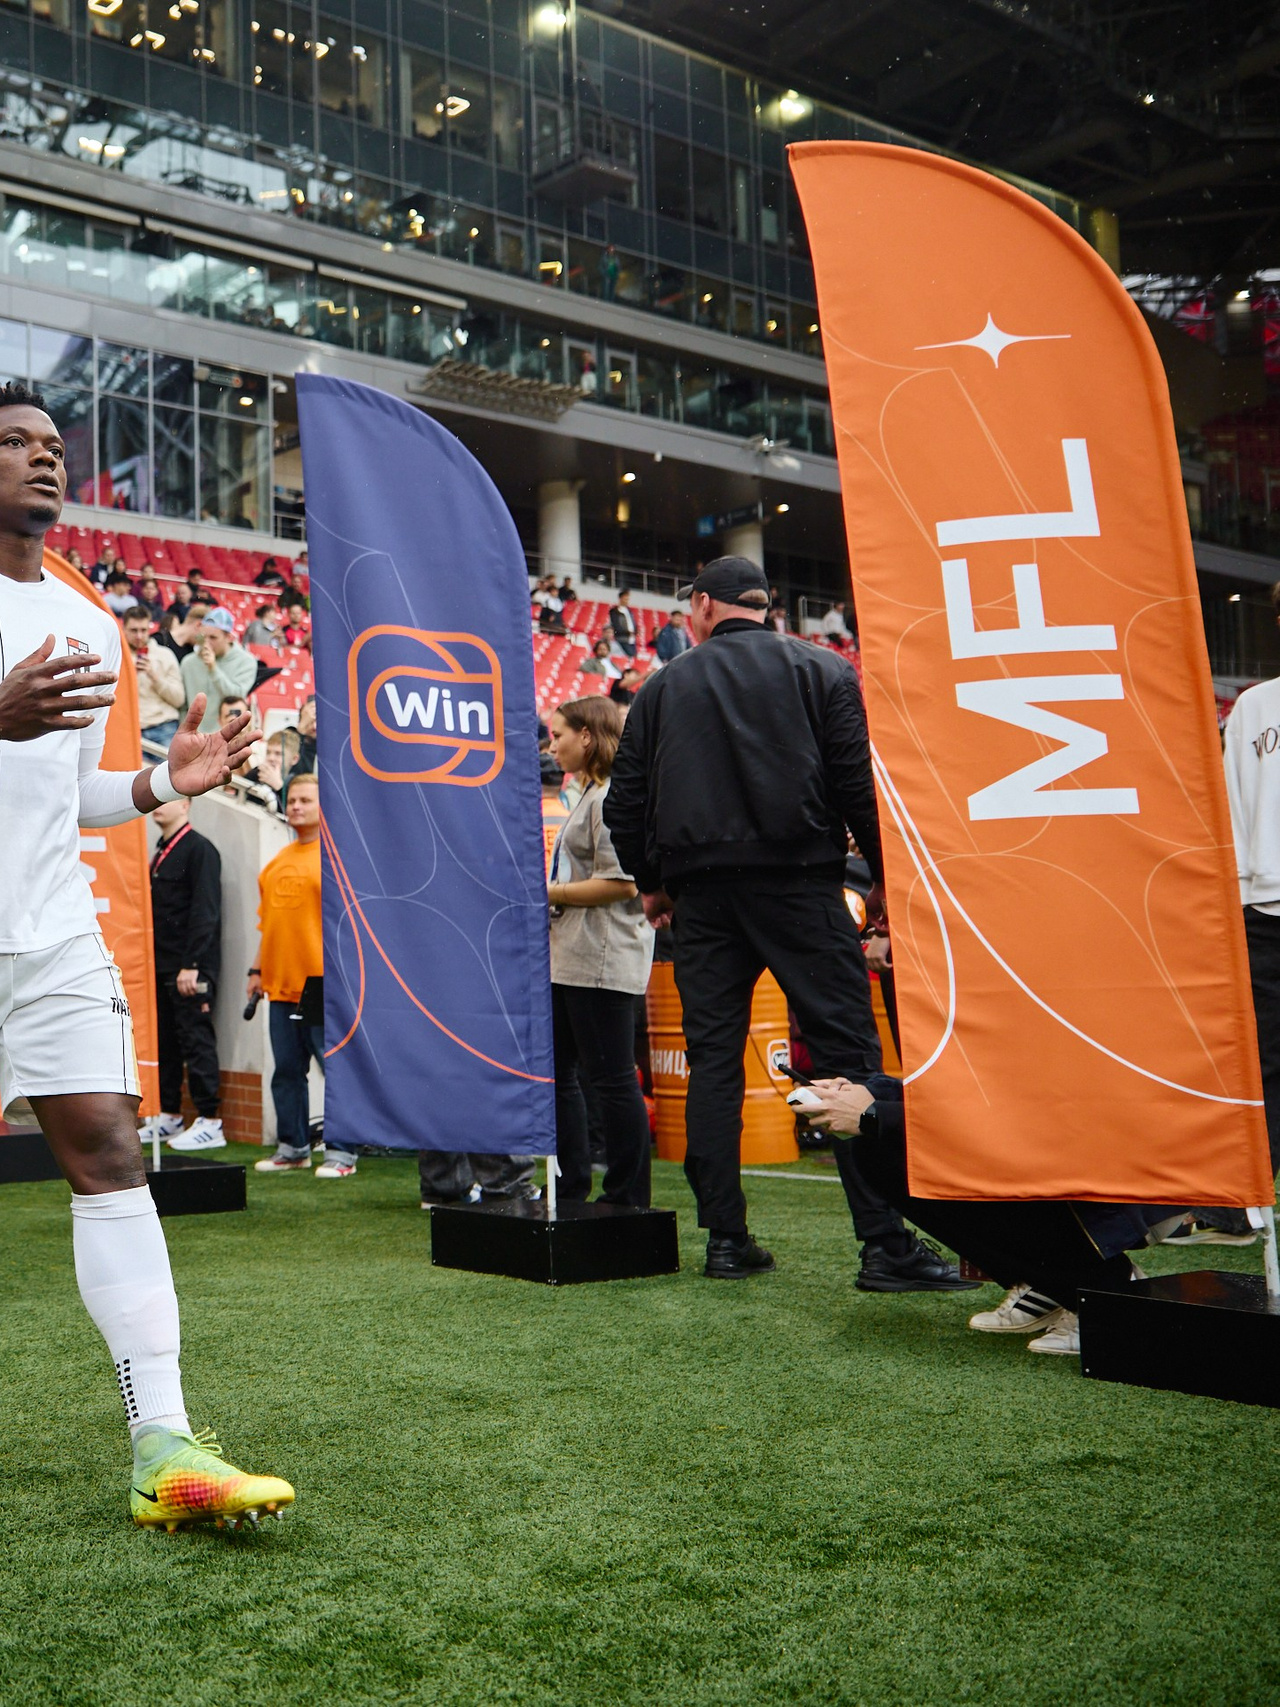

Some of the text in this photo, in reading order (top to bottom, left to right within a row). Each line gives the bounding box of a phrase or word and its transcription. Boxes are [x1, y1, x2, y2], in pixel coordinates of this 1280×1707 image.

[936, 438, 1140, 821] MFL
[384, 683, 490, 735] Win
[1251, 725, 1280, 763] WO
